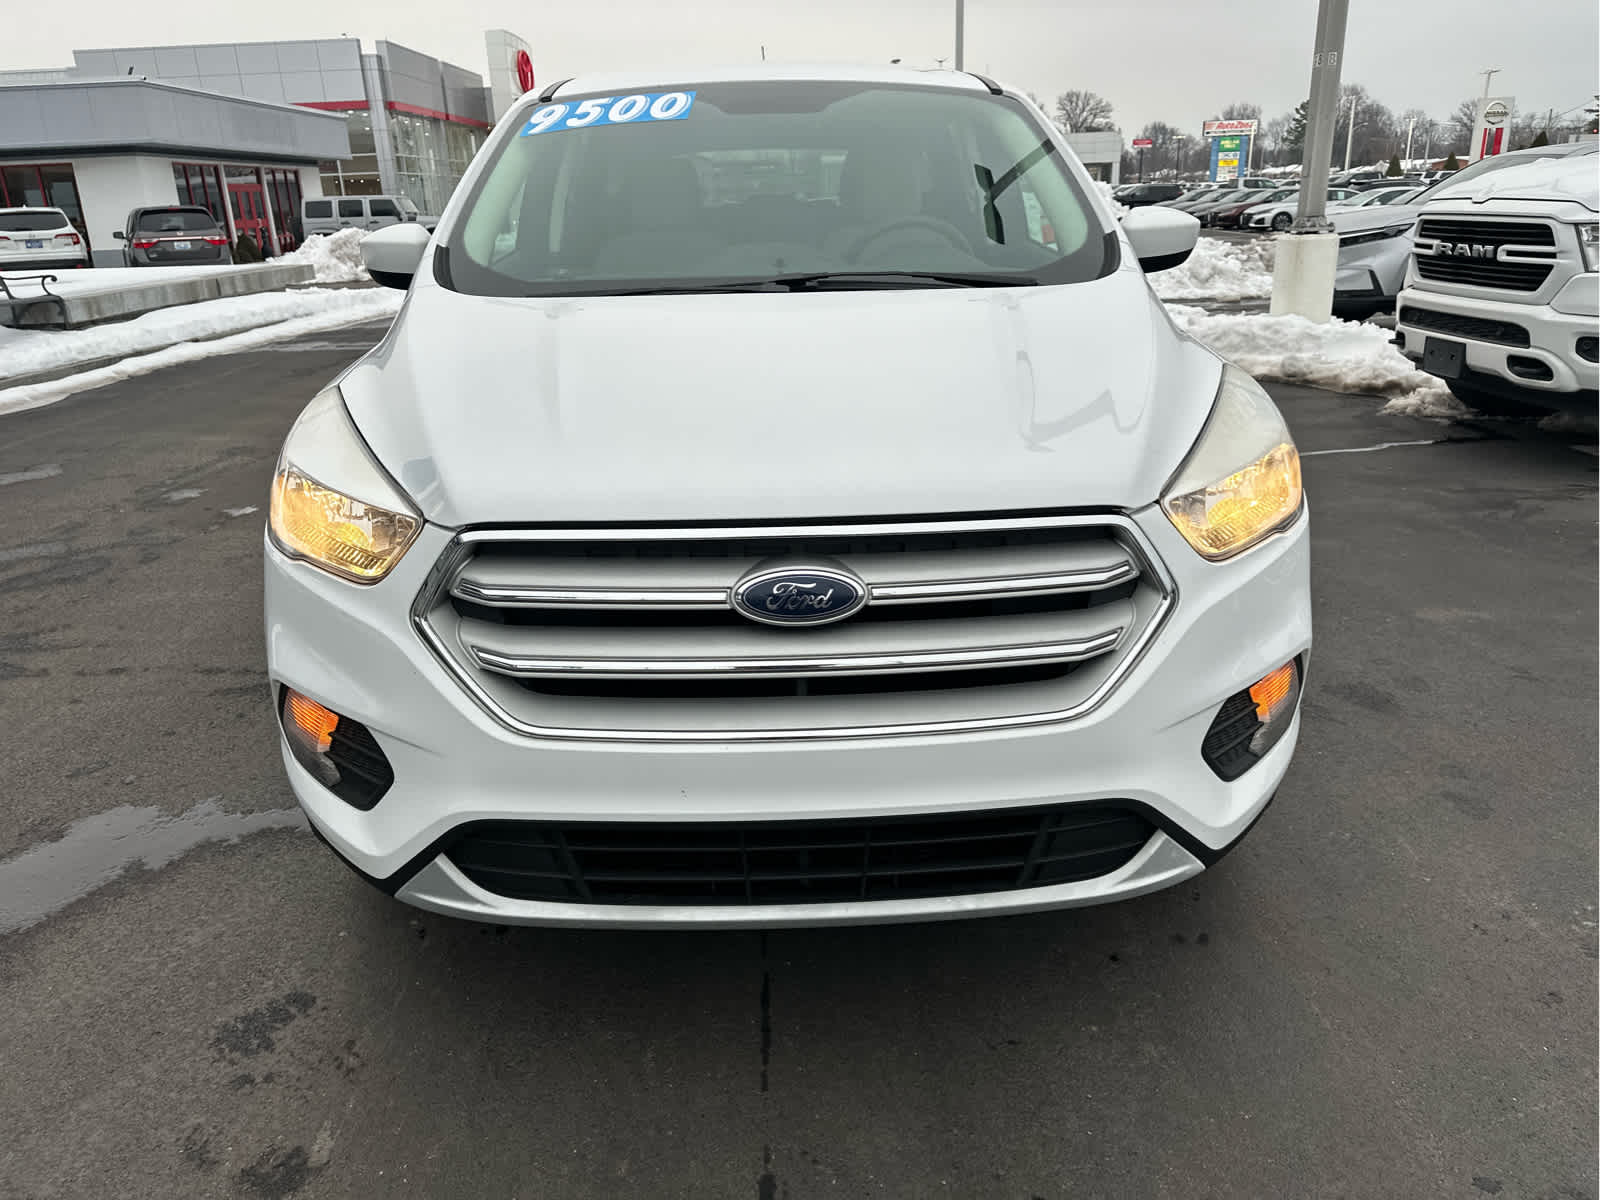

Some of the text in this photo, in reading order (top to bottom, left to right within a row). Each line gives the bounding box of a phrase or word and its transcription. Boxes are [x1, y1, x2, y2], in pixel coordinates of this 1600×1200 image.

[527, 92, 692, 135] 9500
[1435, 242, 1495, 258] RAM
[766, 582, 834, 610] Ford
